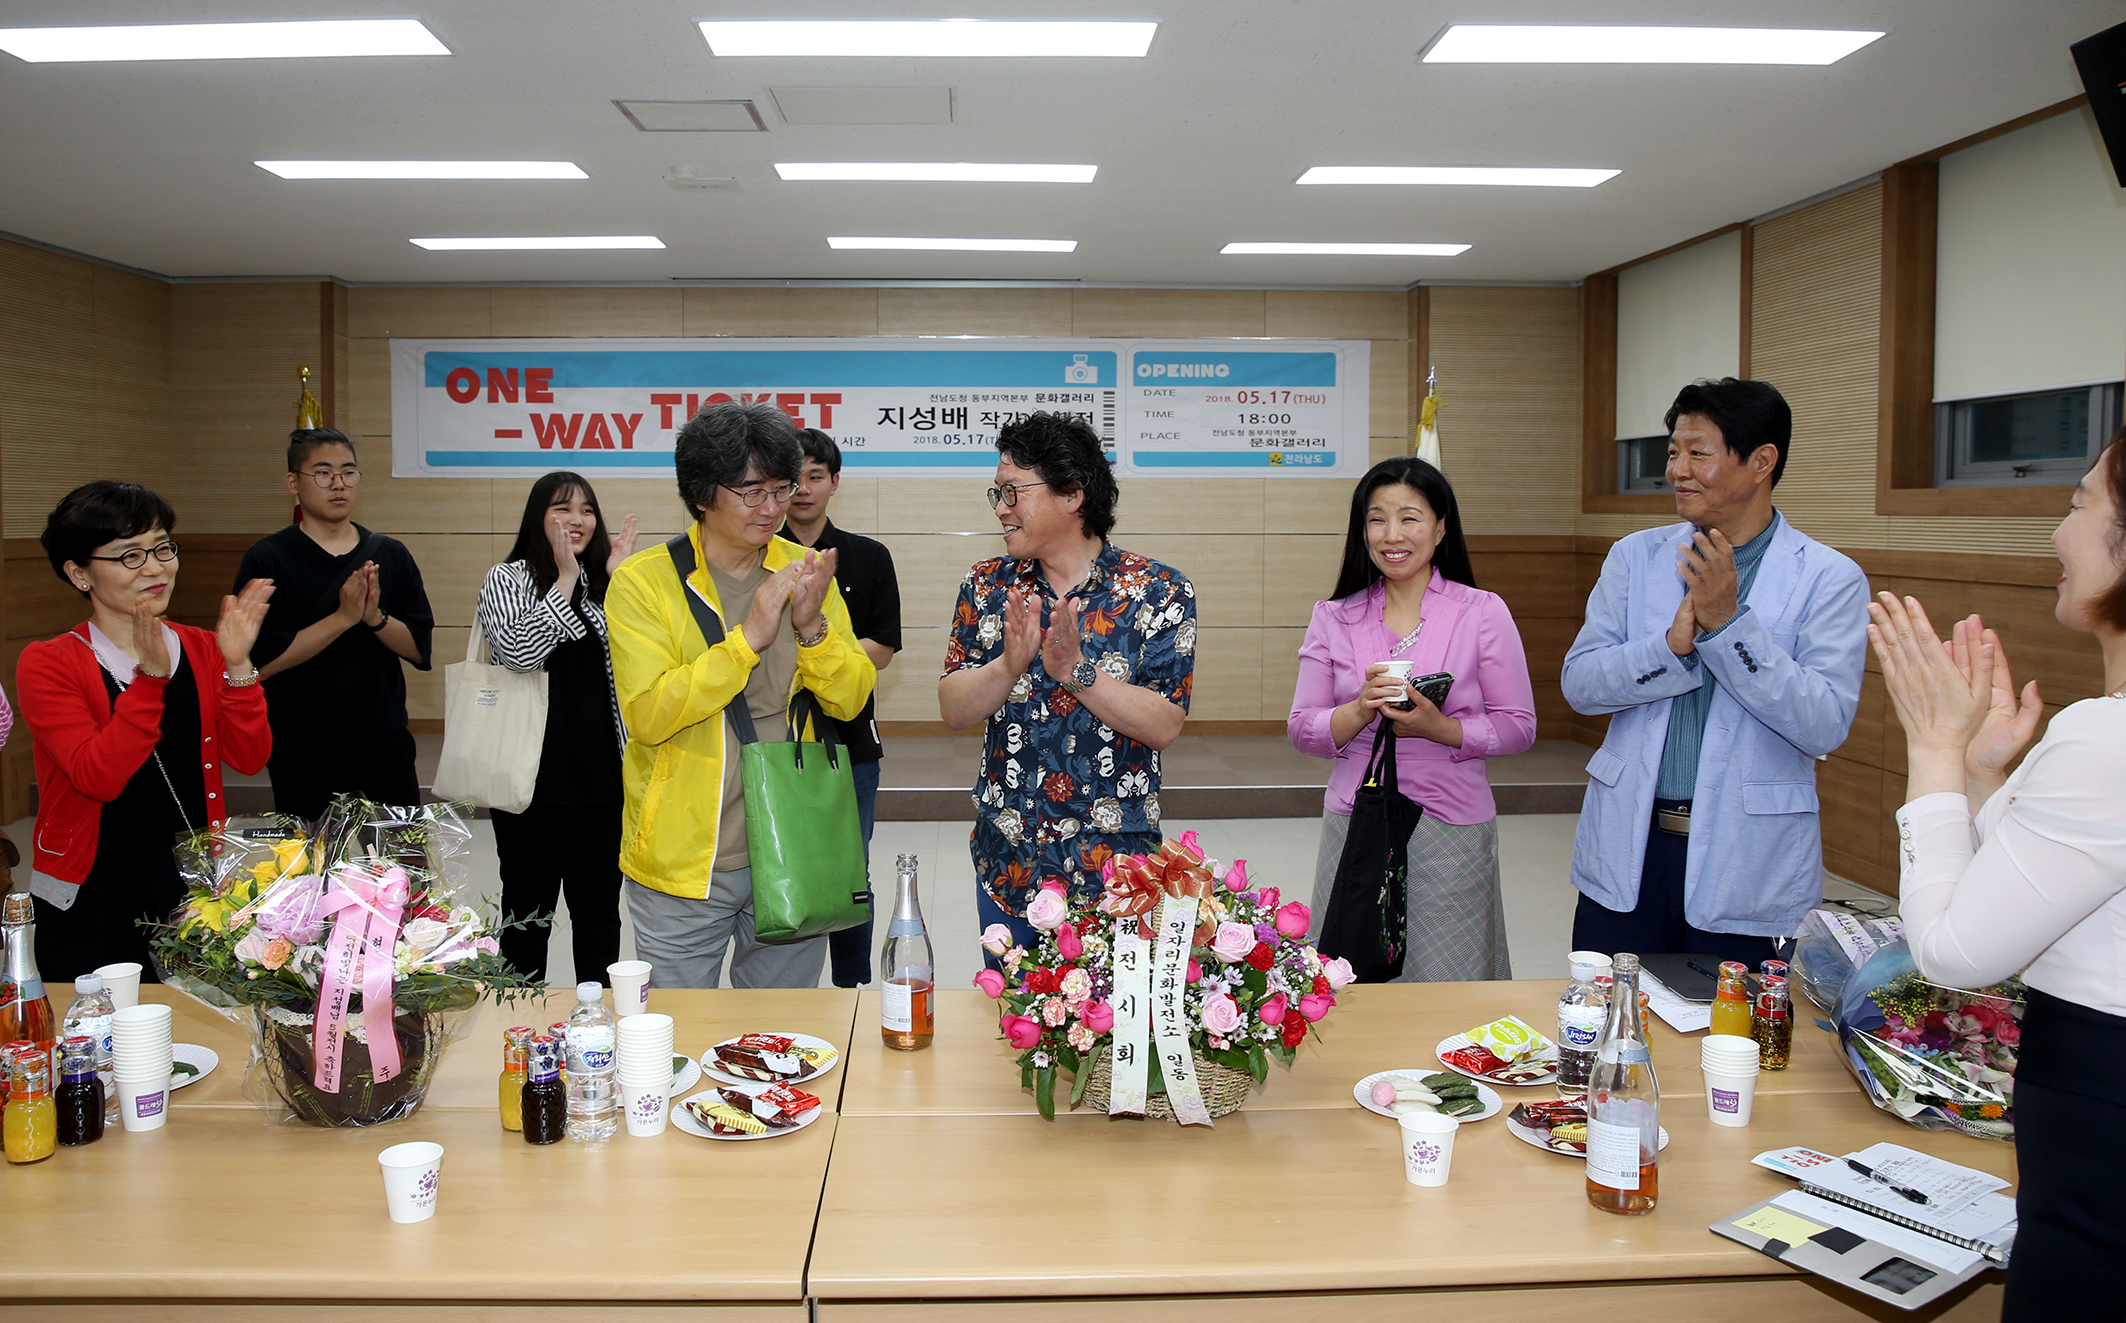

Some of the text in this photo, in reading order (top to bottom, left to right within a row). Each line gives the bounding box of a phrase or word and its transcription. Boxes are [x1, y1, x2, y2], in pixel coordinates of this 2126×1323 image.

[1137, 363, 1230, 377] OPENING
[446, 367, 554, 404] ONE
[929, 393, 1095, 404] 전남도청 동부지역본부 문화갤러리
[651, 392, 842, 430] TIET
[1144, 410, 1174, 418] TIME
[877, 406, 968, 431] 지성배
[1238, 413, 1291, 424] 18:00
[1140, 431, 1181, 440] PLACE
[1212, 429, 1297, 437] 전남도청 동부지역본부
[842, 436, 866, 446] 시간
[1250, 438, 1326, 448] 문화갤러리
[1284, 453, 1323, 464] 전라남도
[1159, 921, 1189, 1082] 일자리문화발전소 일동
[1569, 1030, 1595, 1041] JIRISAN
[586, 1053, 611, 1064] 지리산
